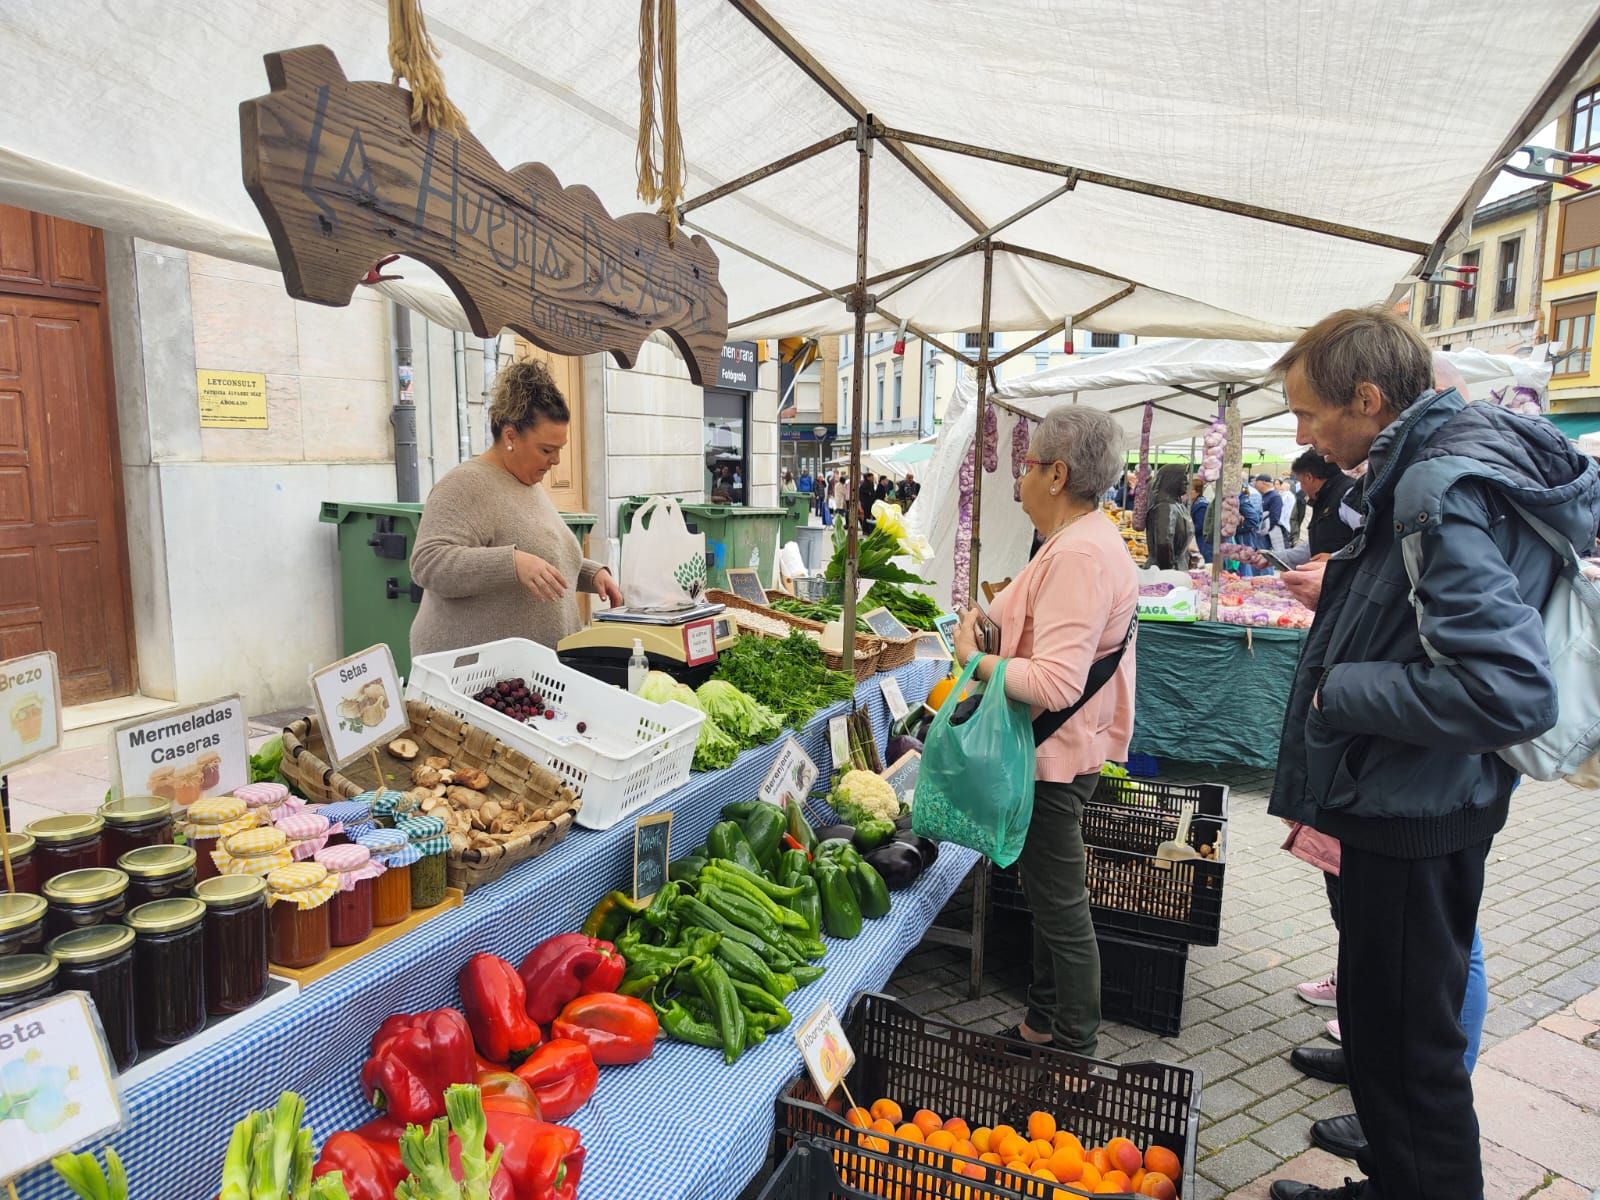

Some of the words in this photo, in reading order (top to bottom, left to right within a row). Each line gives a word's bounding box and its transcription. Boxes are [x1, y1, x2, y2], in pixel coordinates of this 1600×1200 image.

[531, 292, 608, 343] GRADO
[0, 667, 42, 692] Brezo
[340, 662, 368, 683] Setas
[129, 706, 233, 748] Mermeladas
[151, 732, 221, 764] Caseras
[764, 749, 792, 795] Berenjena
